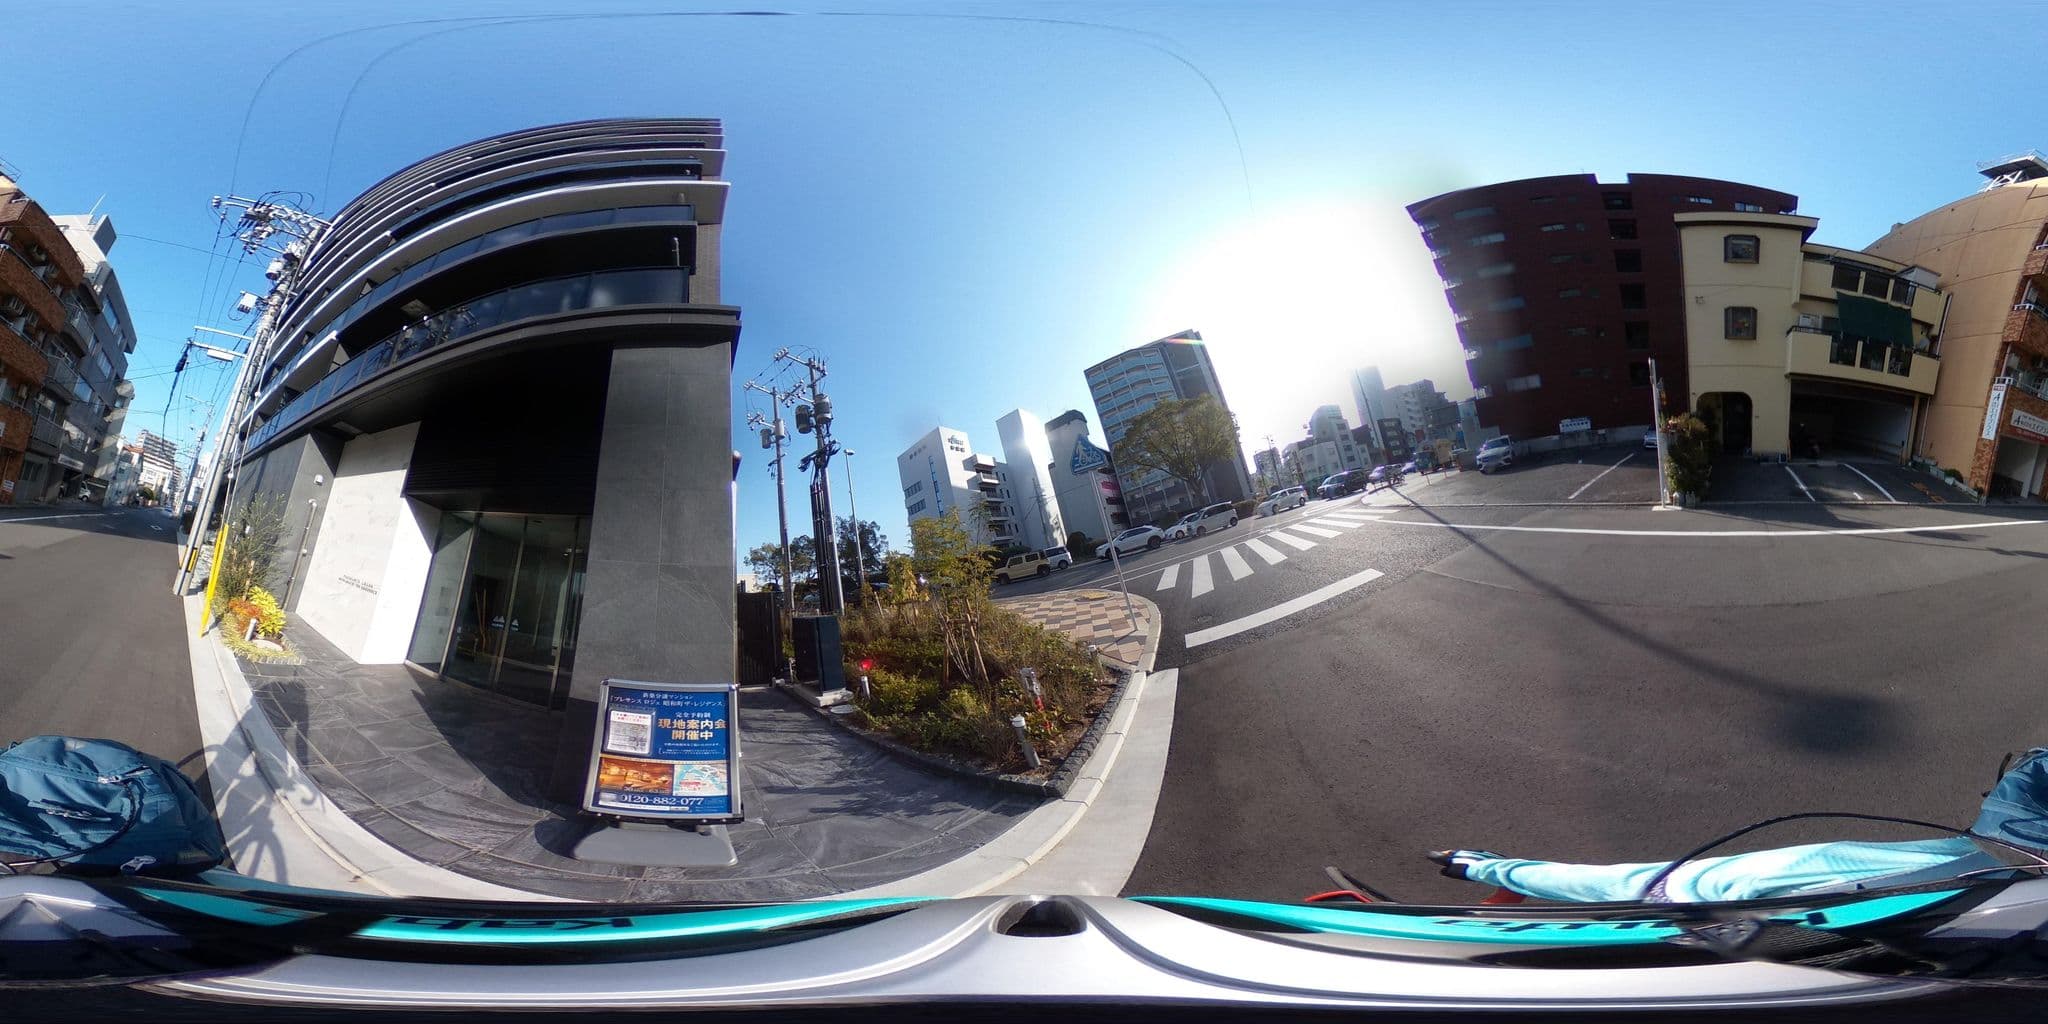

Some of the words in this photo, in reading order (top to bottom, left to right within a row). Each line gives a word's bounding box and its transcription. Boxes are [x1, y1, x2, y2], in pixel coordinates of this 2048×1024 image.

[658, 719, 727, 730] 現地案内会
[672, 730, 713, 740] 開催中
